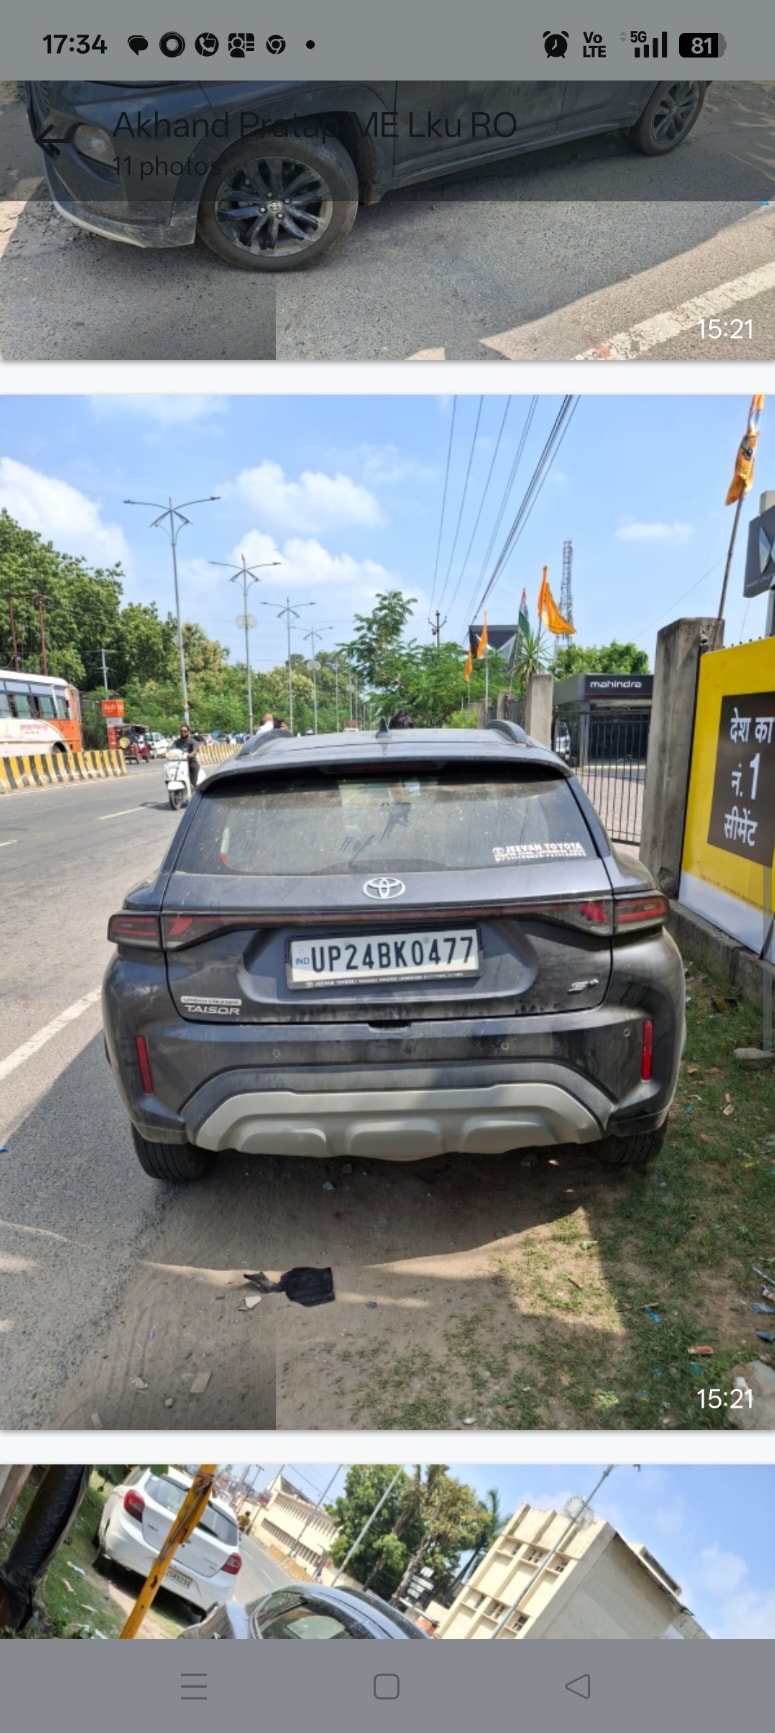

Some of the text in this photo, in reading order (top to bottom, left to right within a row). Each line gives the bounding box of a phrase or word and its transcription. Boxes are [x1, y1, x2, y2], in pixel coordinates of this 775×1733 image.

[589, 680, 642, 688] mahindra
[730, 707, 775, 744] देश का
[731, 753, 761, 800] नं. 1
[723, 806, 758, 846] सीमेंट
[544, 842, 583, 851] TOYOTA
[311, 936, 473, 973] UP24BK0477
[184, 1004, 240, 1016] TAISOR
